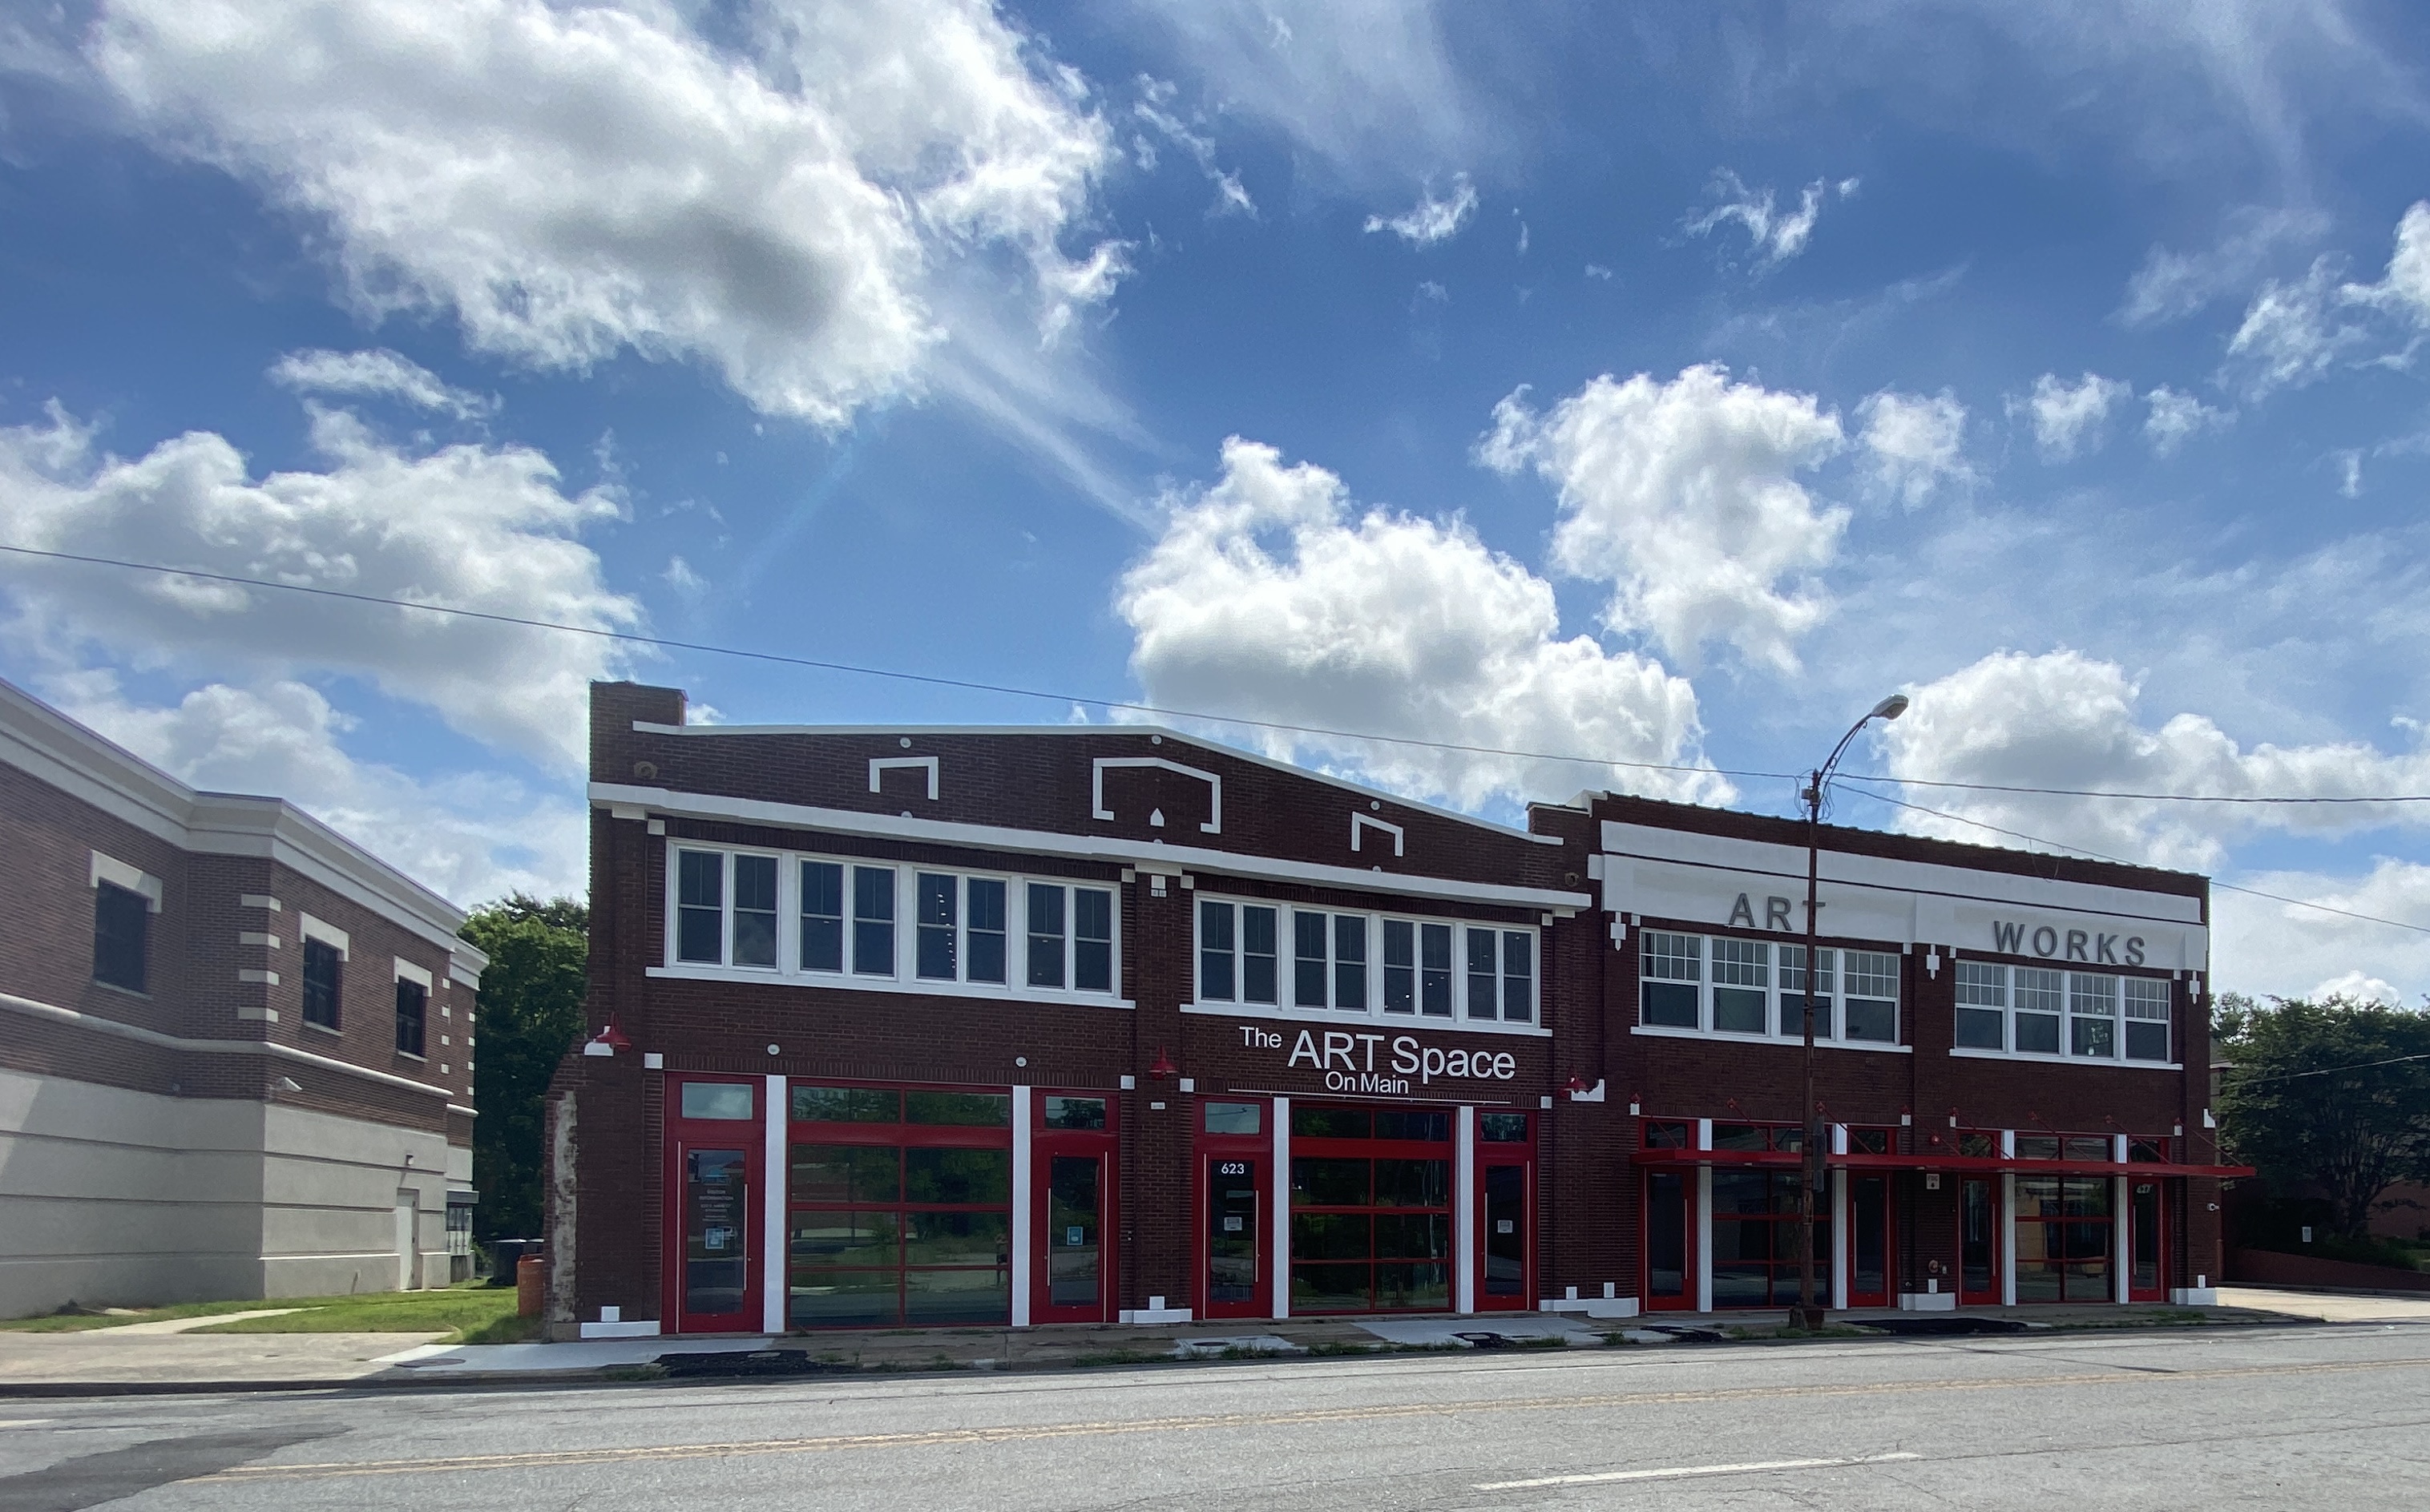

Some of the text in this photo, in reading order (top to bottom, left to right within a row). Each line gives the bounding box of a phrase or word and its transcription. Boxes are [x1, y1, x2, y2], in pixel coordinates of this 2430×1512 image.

[1993, 921, 2145, 967] WORKS
[1239, 1026, 1516, 1085] The ART Space
[1325, 1070, 1410, 1095] On Main
[1221, 1163, 1245, 1175] 623
